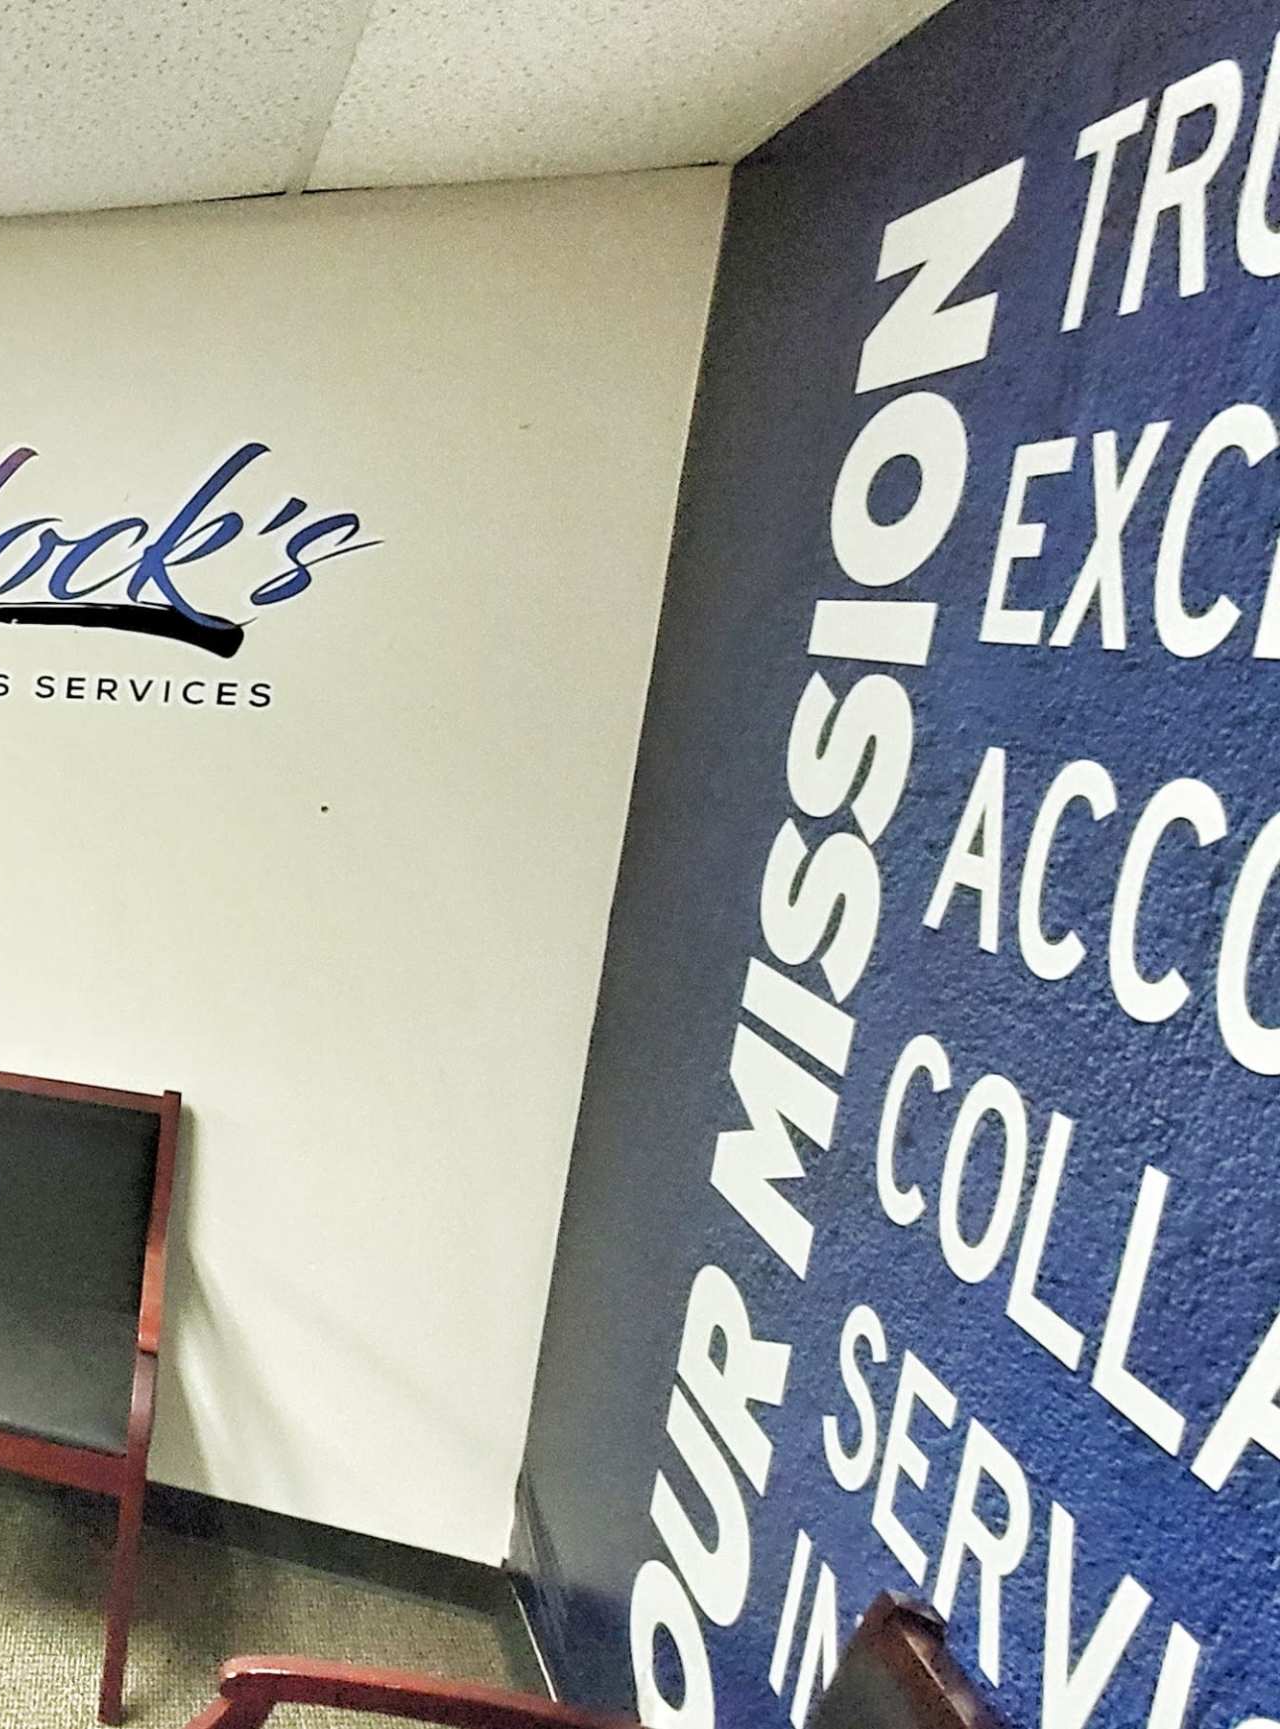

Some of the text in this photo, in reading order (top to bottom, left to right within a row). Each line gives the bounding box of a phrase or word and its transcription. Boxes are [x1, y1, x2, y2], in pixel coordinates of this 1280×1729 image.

[35, 675, 274, 709] SERVICES
[979, 403, 1280, 660] EXC
[630, 157, 1025, 1729] OUR MISSION
[823, 1304, 1280, 1729] SERV
